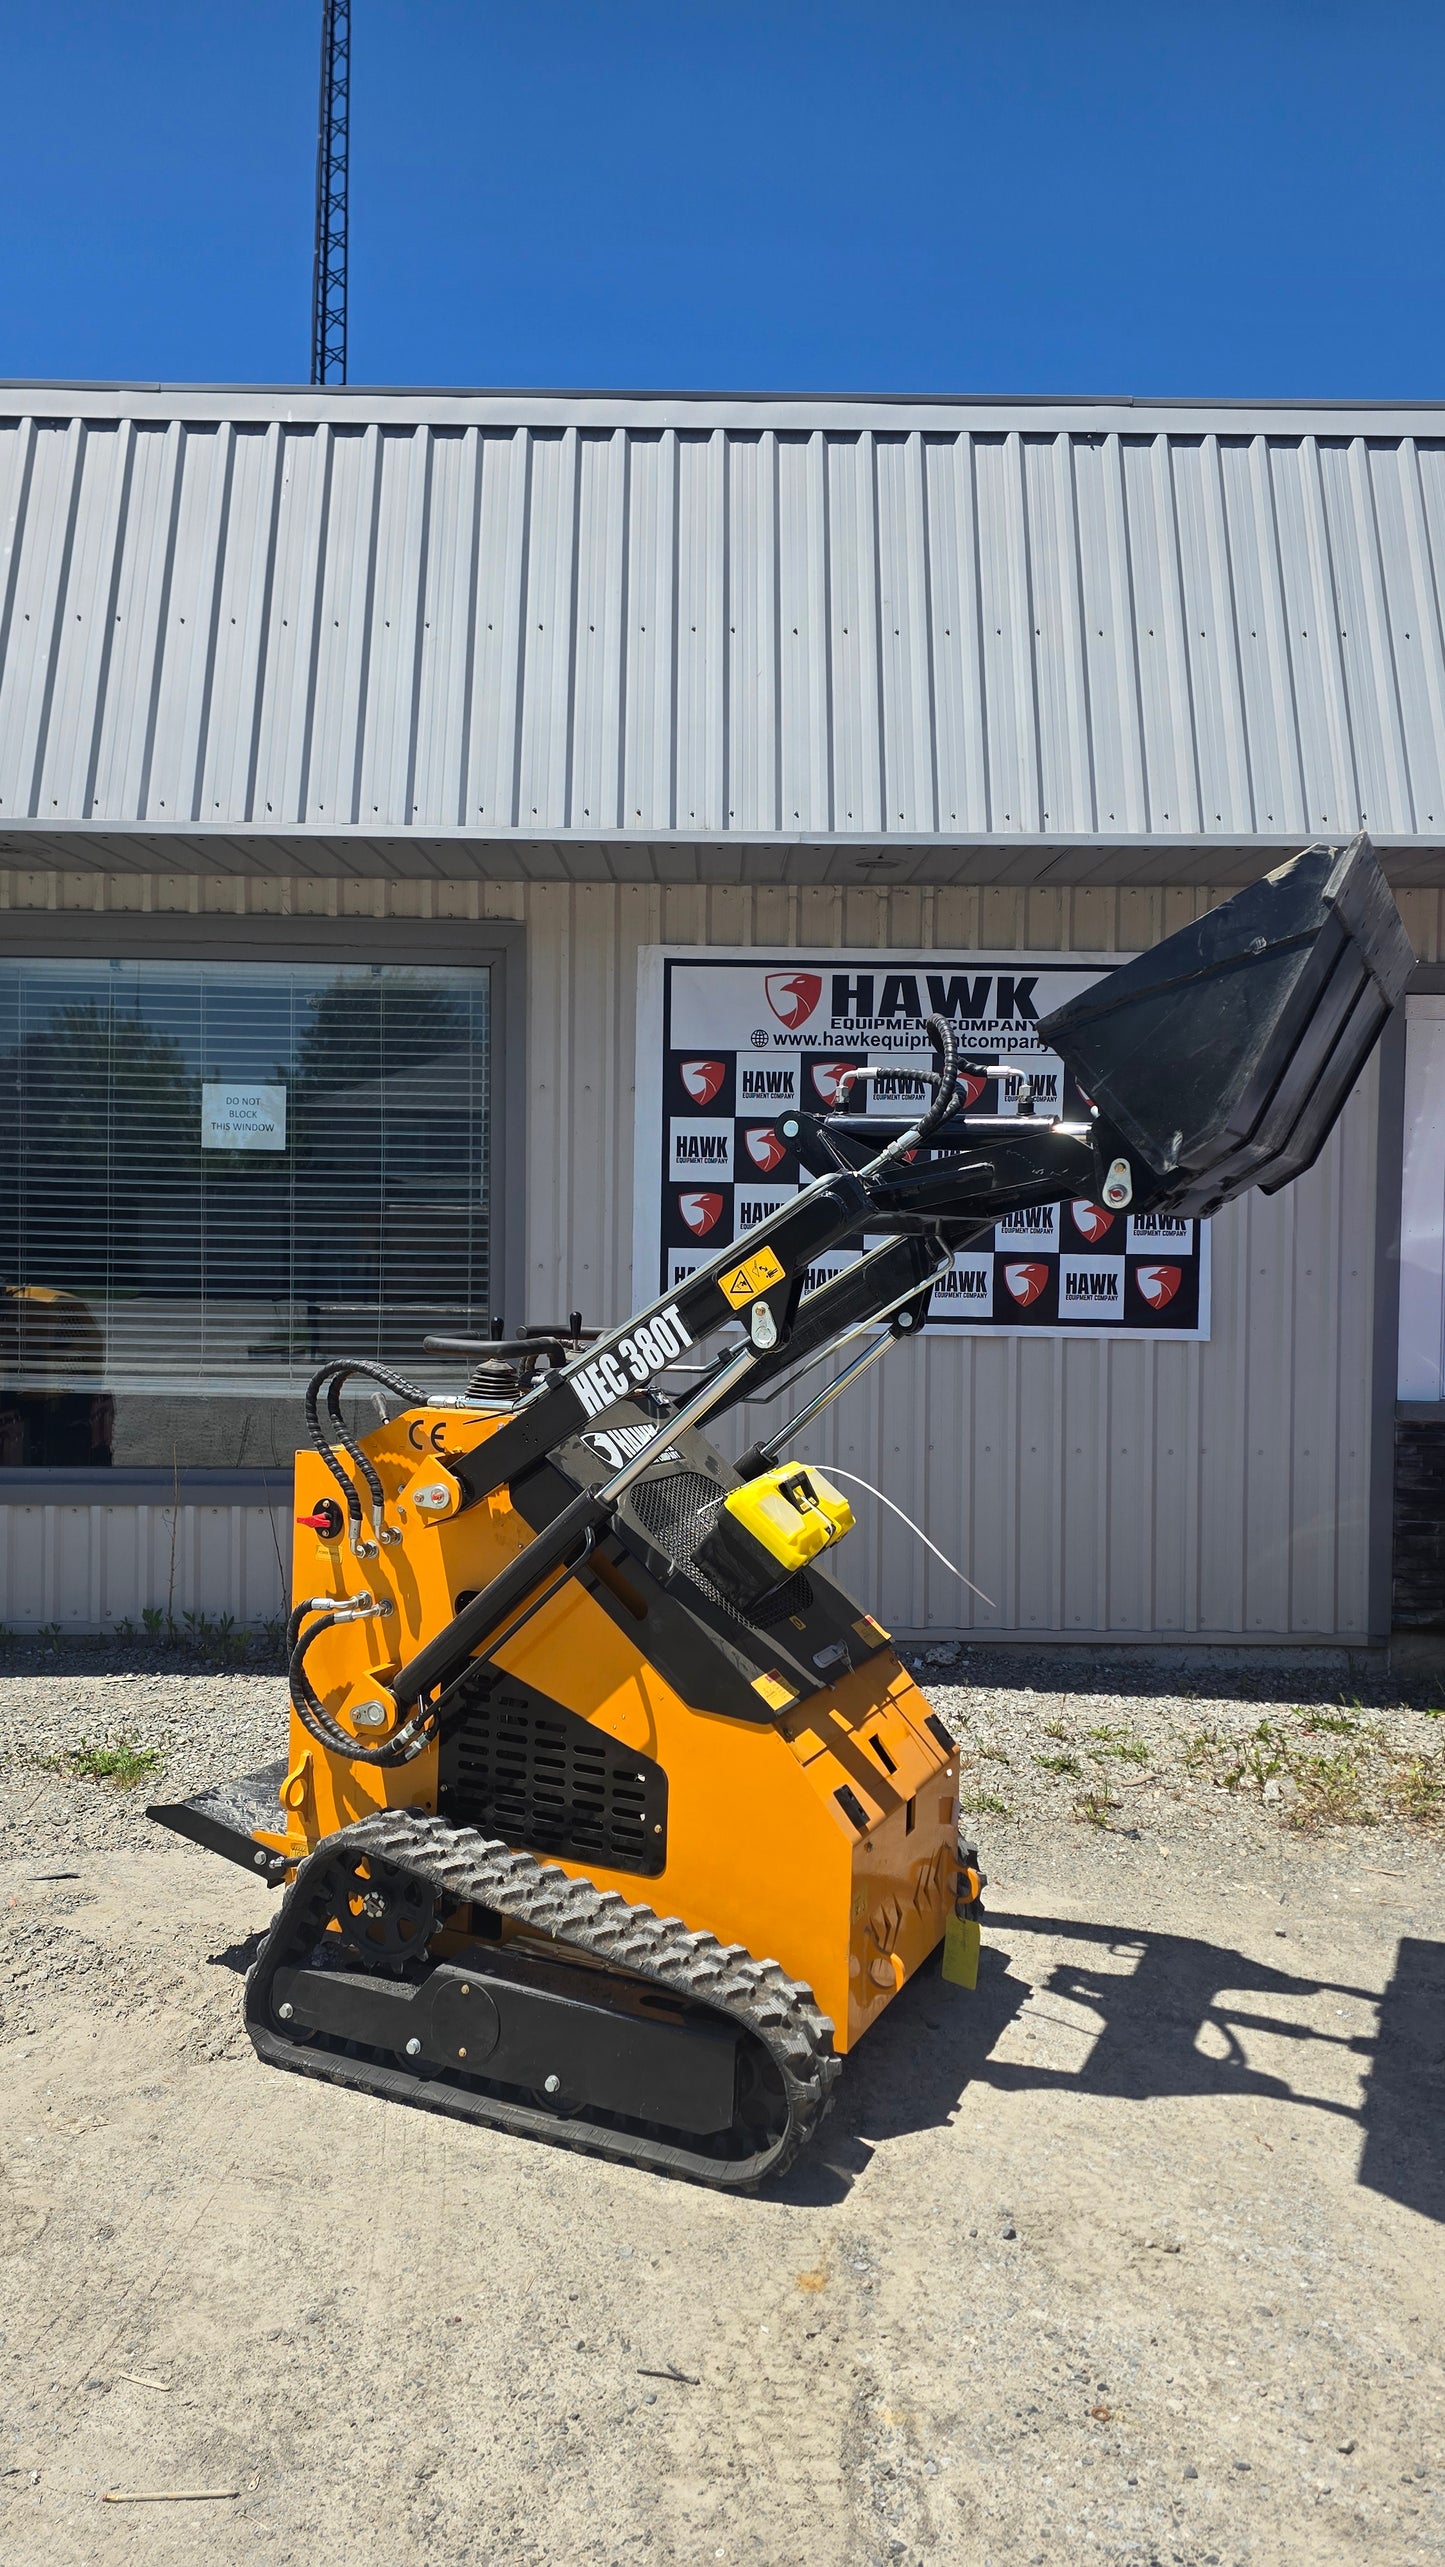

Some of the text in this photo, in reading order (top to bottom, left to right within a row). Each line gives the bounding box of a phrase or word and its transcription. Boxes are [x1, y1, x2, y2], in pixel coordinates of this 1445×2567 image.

[831, 975, 1040, 1020] HAWK
[831, 1018, 927, 1031] EQUIPMEN
[743, 1071, 794, 1092] HAWK
[873, 1077, 926, 1094] HAWK
[226, 1097, 261, 1106] DO NOT
[229, 1110, 257, 1118] BLOCK
[211, 1122, 274, 1132] THIS WINDOW
[676, 1135, 728, 1157] HAWK
[740, 1202, 786, 1224] HAW
[1001, 1206, 1053, 1228] HAWK
[934, 1271, 987, 1292] HAWK
[1066, 1273, 1118, 1295] HAWK
[569, 1303, 694, 1418] HEC 380T
